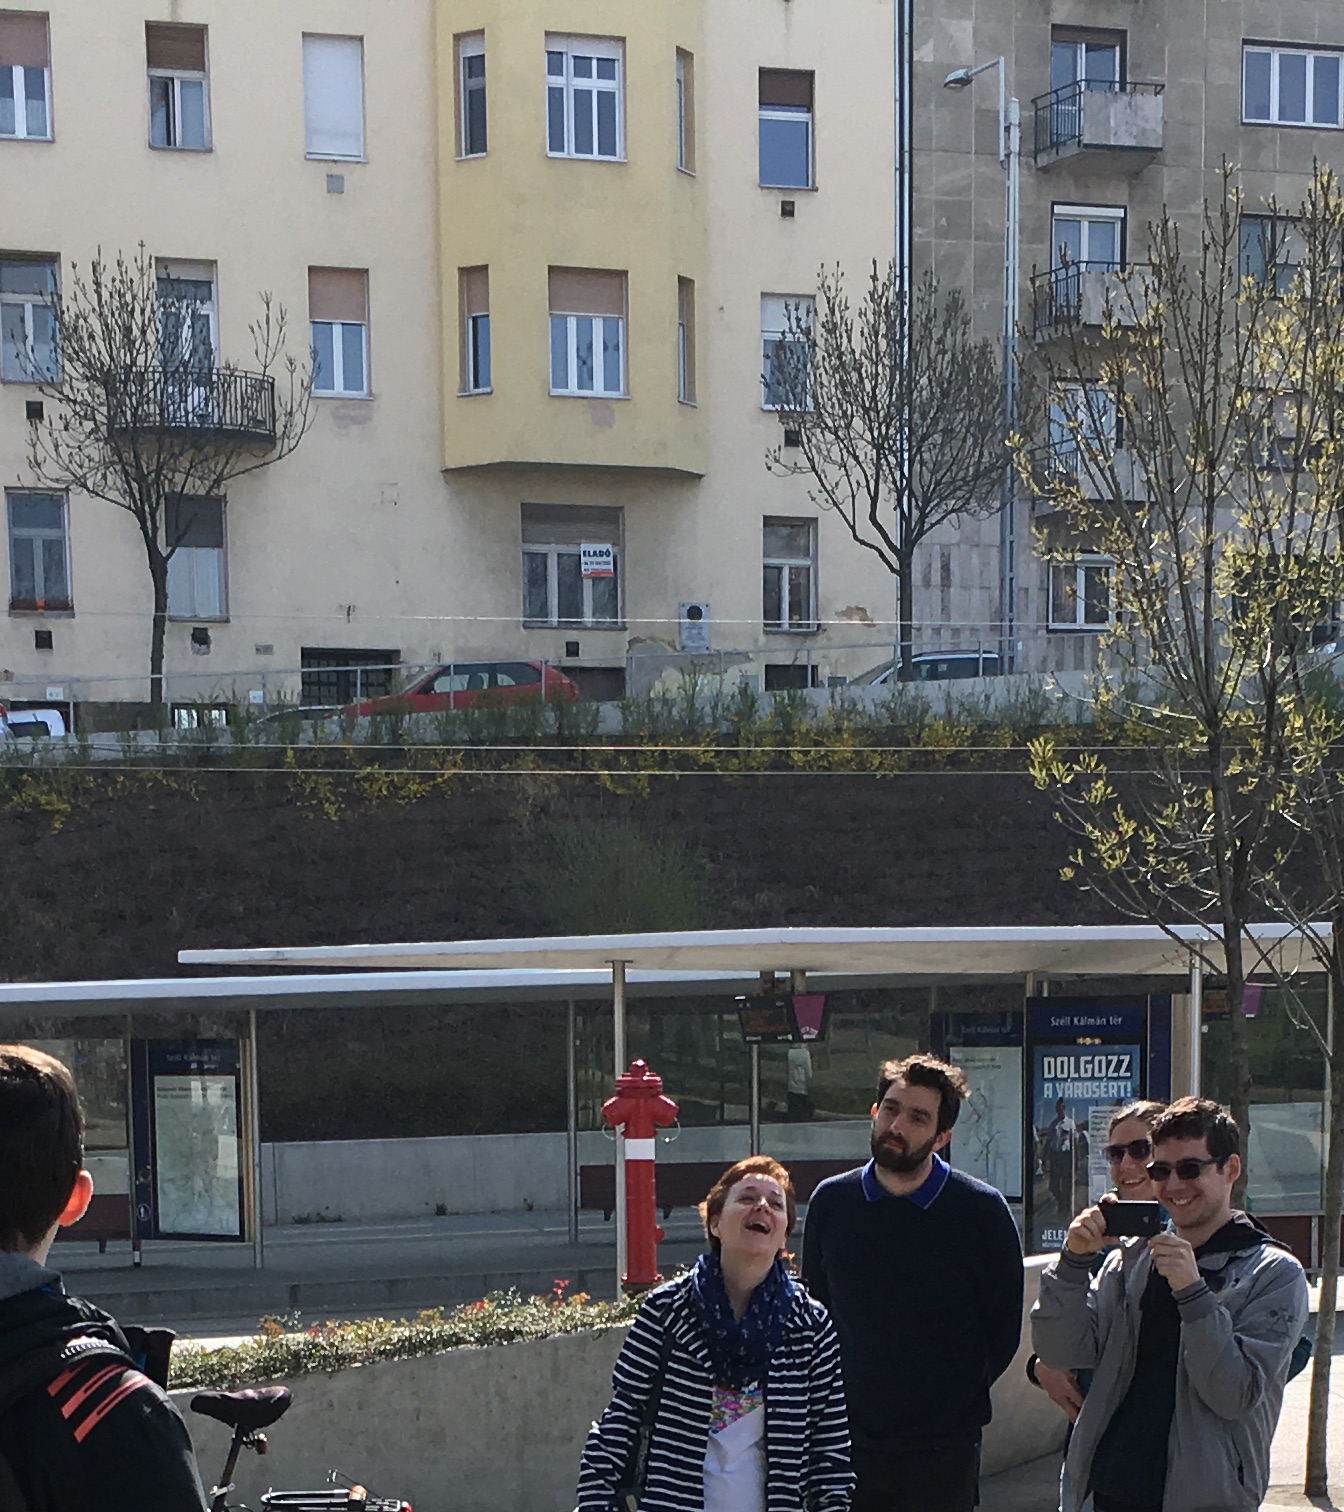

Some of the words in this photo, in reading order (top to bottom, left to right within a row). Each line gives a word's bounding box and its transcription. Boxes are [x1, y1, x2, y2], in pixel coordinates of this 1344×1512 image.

[1050, 1015, 1071, 1027] Széll
[1073, 1015, 1107, 1026] Kálmán
[1109, 1014, 1123, 1026] tér
[1043, 1054, 1131, 1079] DOLGOZZ
[1044, 1082, 1053, 1098] A
[1056, 1077, 1132, 1098] VÁROSÉRT!
